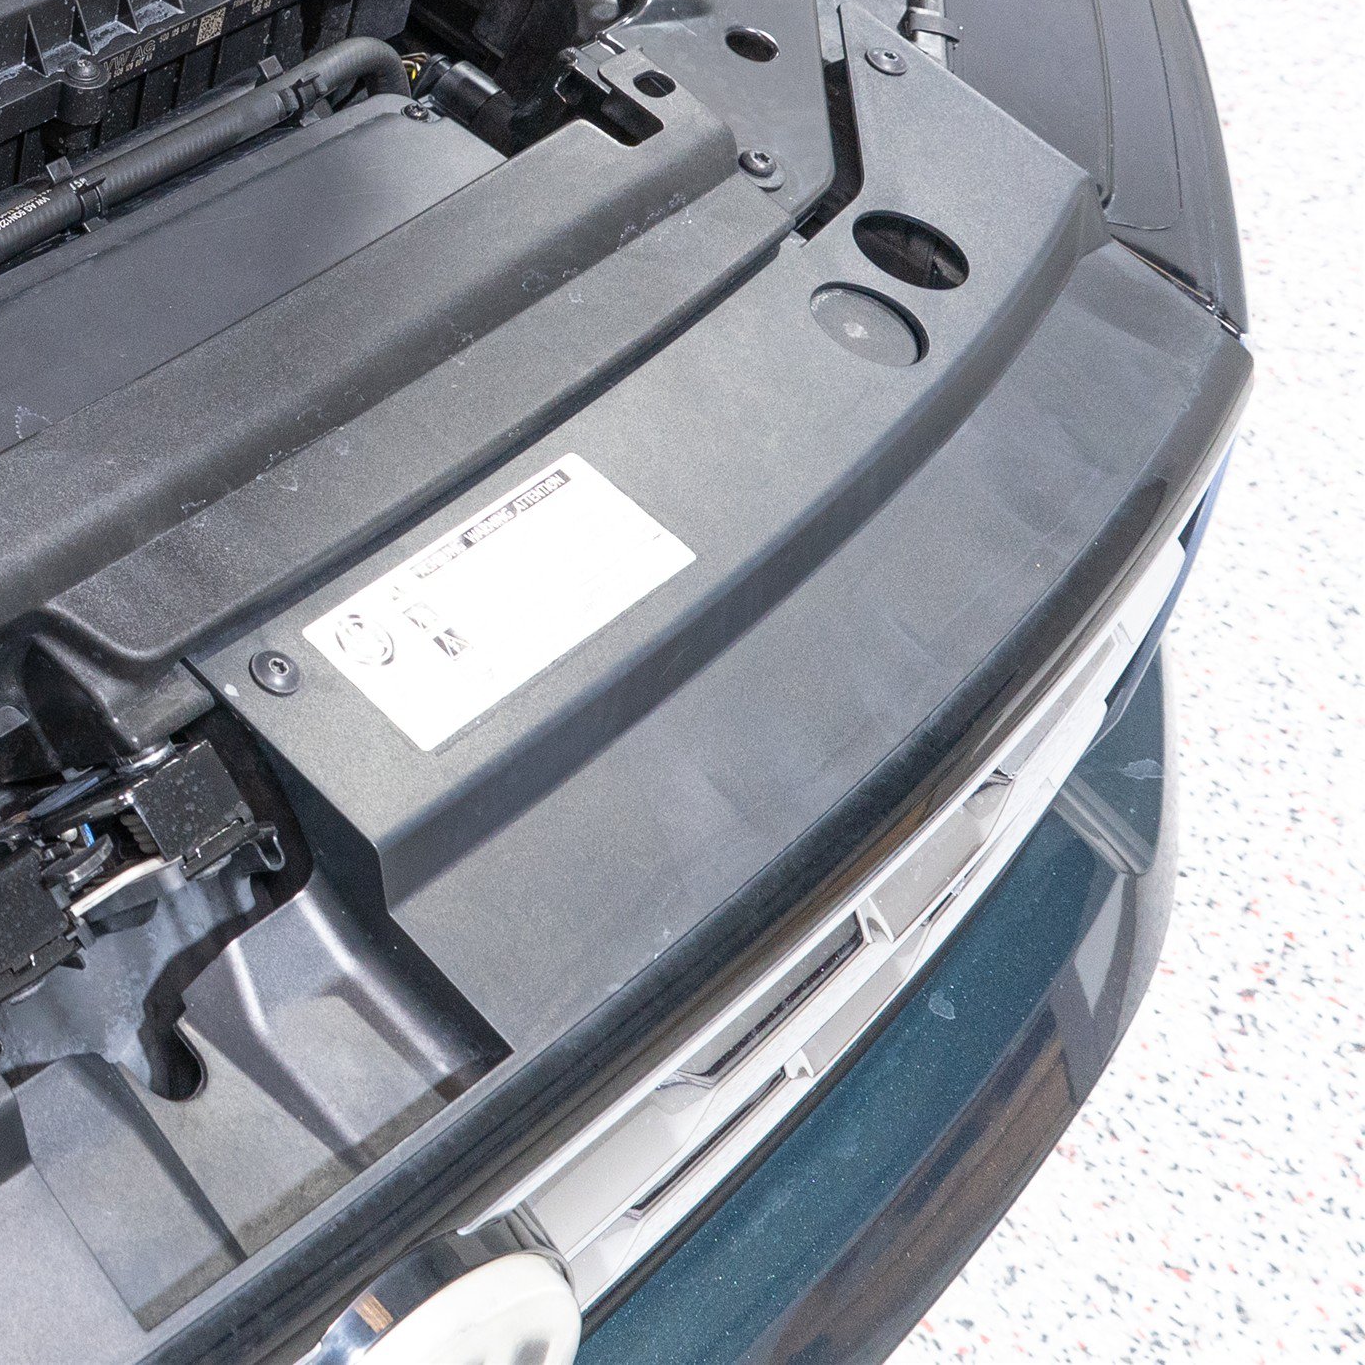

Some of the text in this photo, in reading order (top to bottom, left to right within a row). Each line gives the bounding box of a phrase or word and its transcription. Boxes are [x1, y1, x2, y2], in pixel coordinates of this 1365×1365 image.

[102, 38, 155, 73] VW AG
[22, 201, 37, 214] AG
[34, 195, 51, 207] VW
[462, 504, 516, 546] WARNING
[512, 471, 566, 512] ATTENTION
